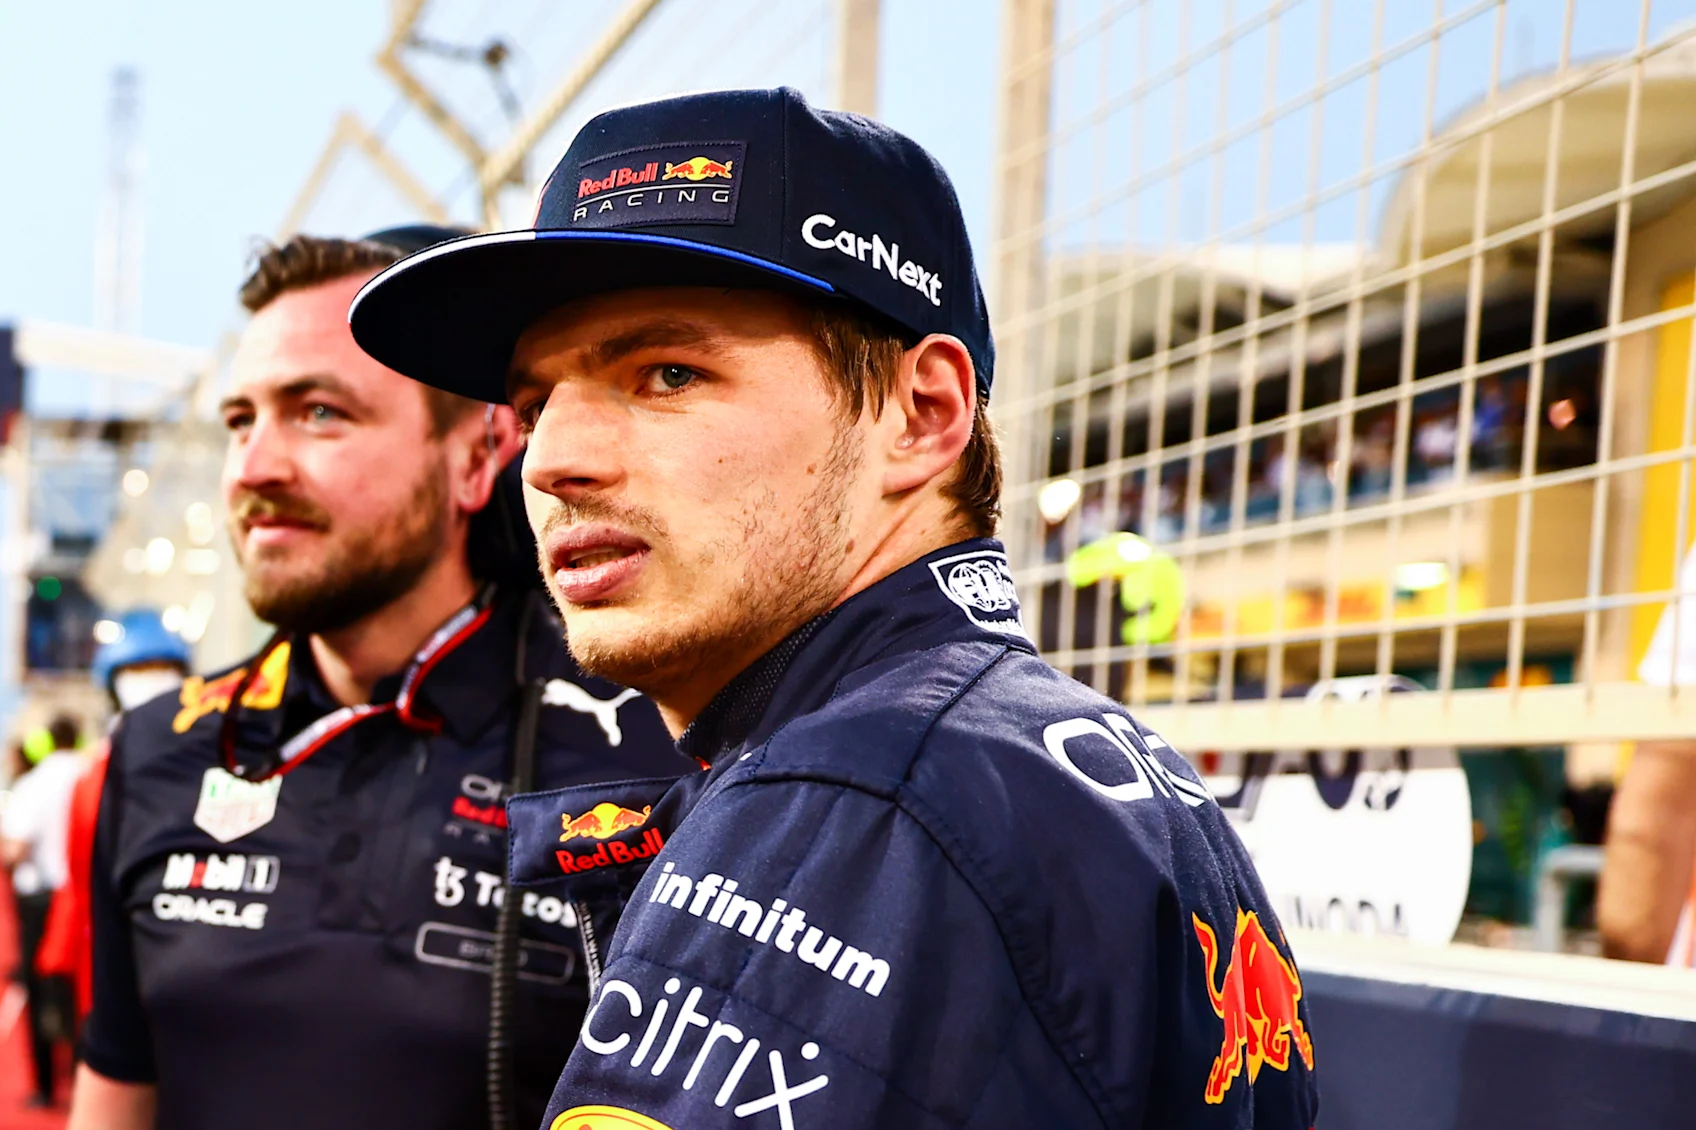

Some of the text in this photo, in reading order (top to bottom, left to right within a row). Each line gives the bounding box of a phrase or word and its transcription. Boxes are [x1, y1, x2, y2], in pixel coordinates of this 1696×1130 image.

[573, 189, 730, 221] RACING
[801, 213, 943, 306] CarNext
[152, 892, 269, 930] ORACLE
[648, 861, 892, 998] infinitum
